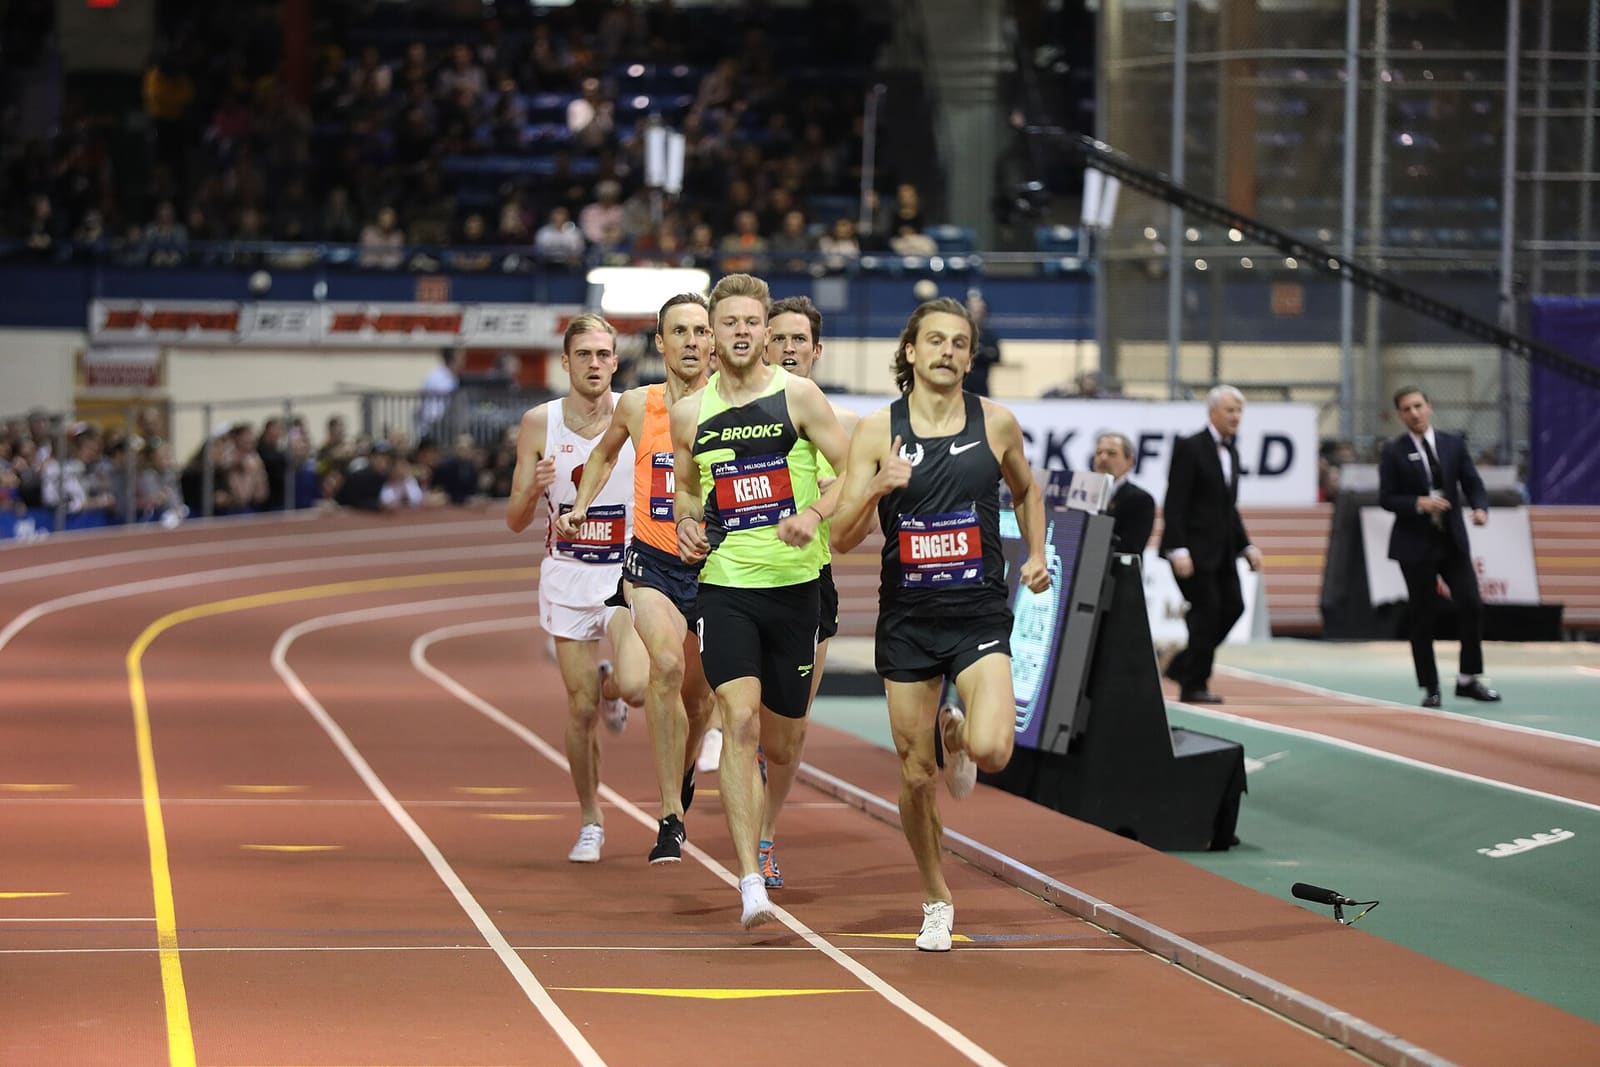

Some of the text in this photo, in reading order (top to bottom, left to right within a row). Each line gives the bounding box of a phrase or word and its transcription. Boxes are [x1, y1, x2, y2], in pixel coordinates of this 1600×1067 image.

[721, 423, 784, 441] BROOKS
[744, 458, 785, 471] MILLROSE GAMES
[733, 475, 773, 503] KERR
[576, 521, 612, 541] OARE
[911, 532, 969, 560] ENGELS
